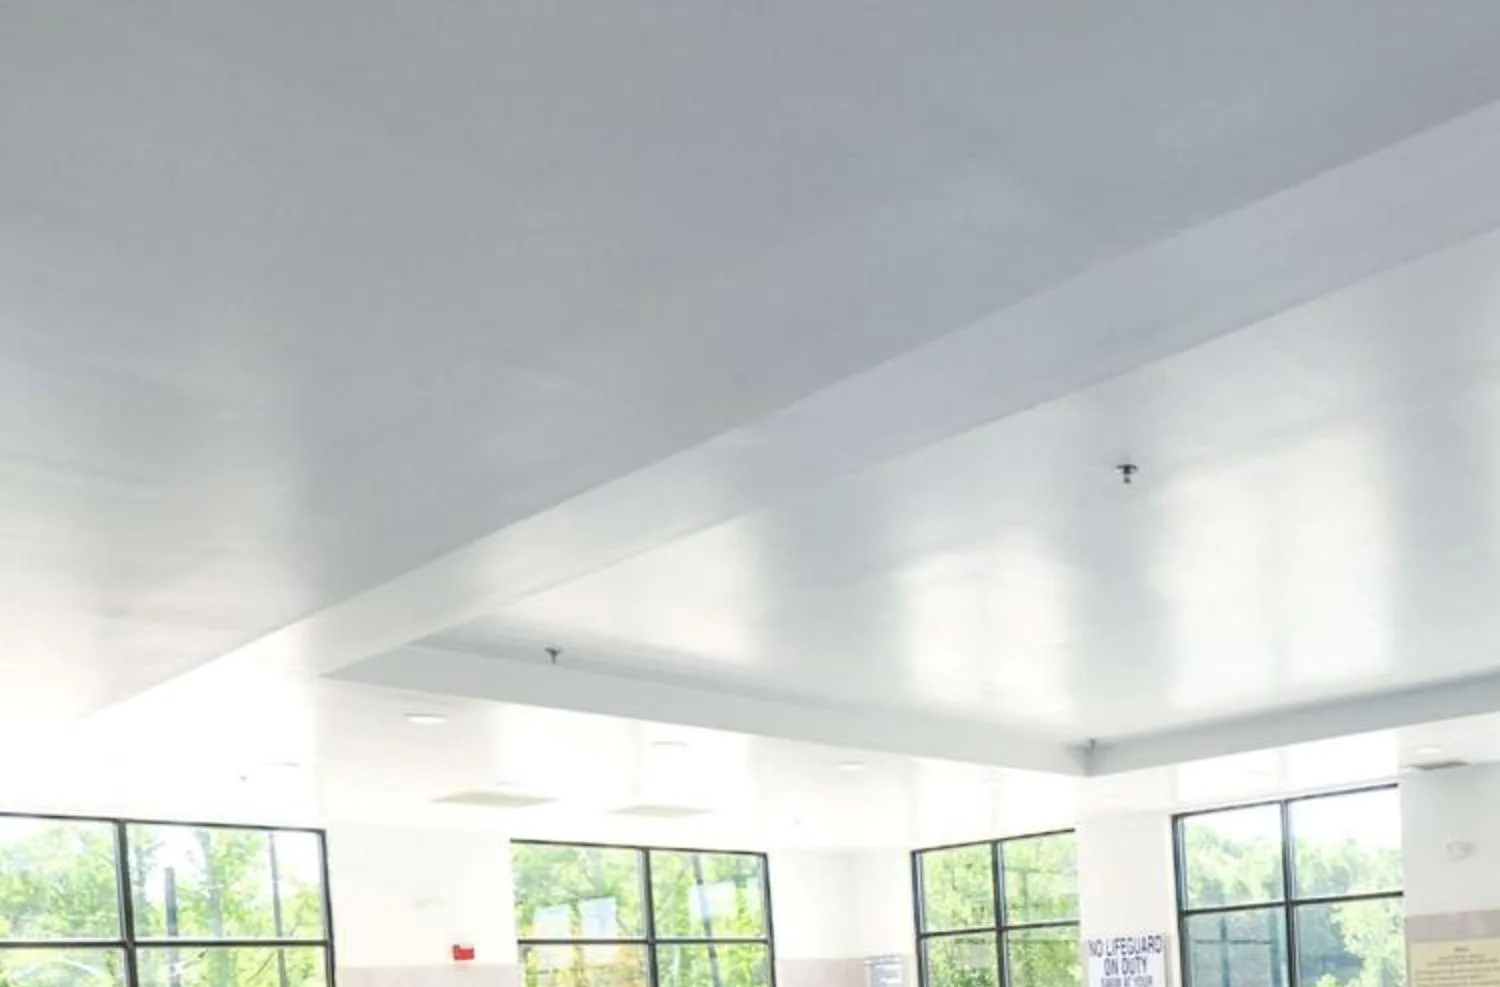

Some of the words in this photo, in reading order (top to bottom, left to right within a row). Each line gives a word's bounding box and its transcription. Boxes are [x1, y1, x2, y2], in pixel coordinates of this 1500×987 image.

[1105, 934, 1162, 956] LIFEGUARD
[1104, 957, 1119, 976] ON
[1121, 955, 1147, 975] DUTY
